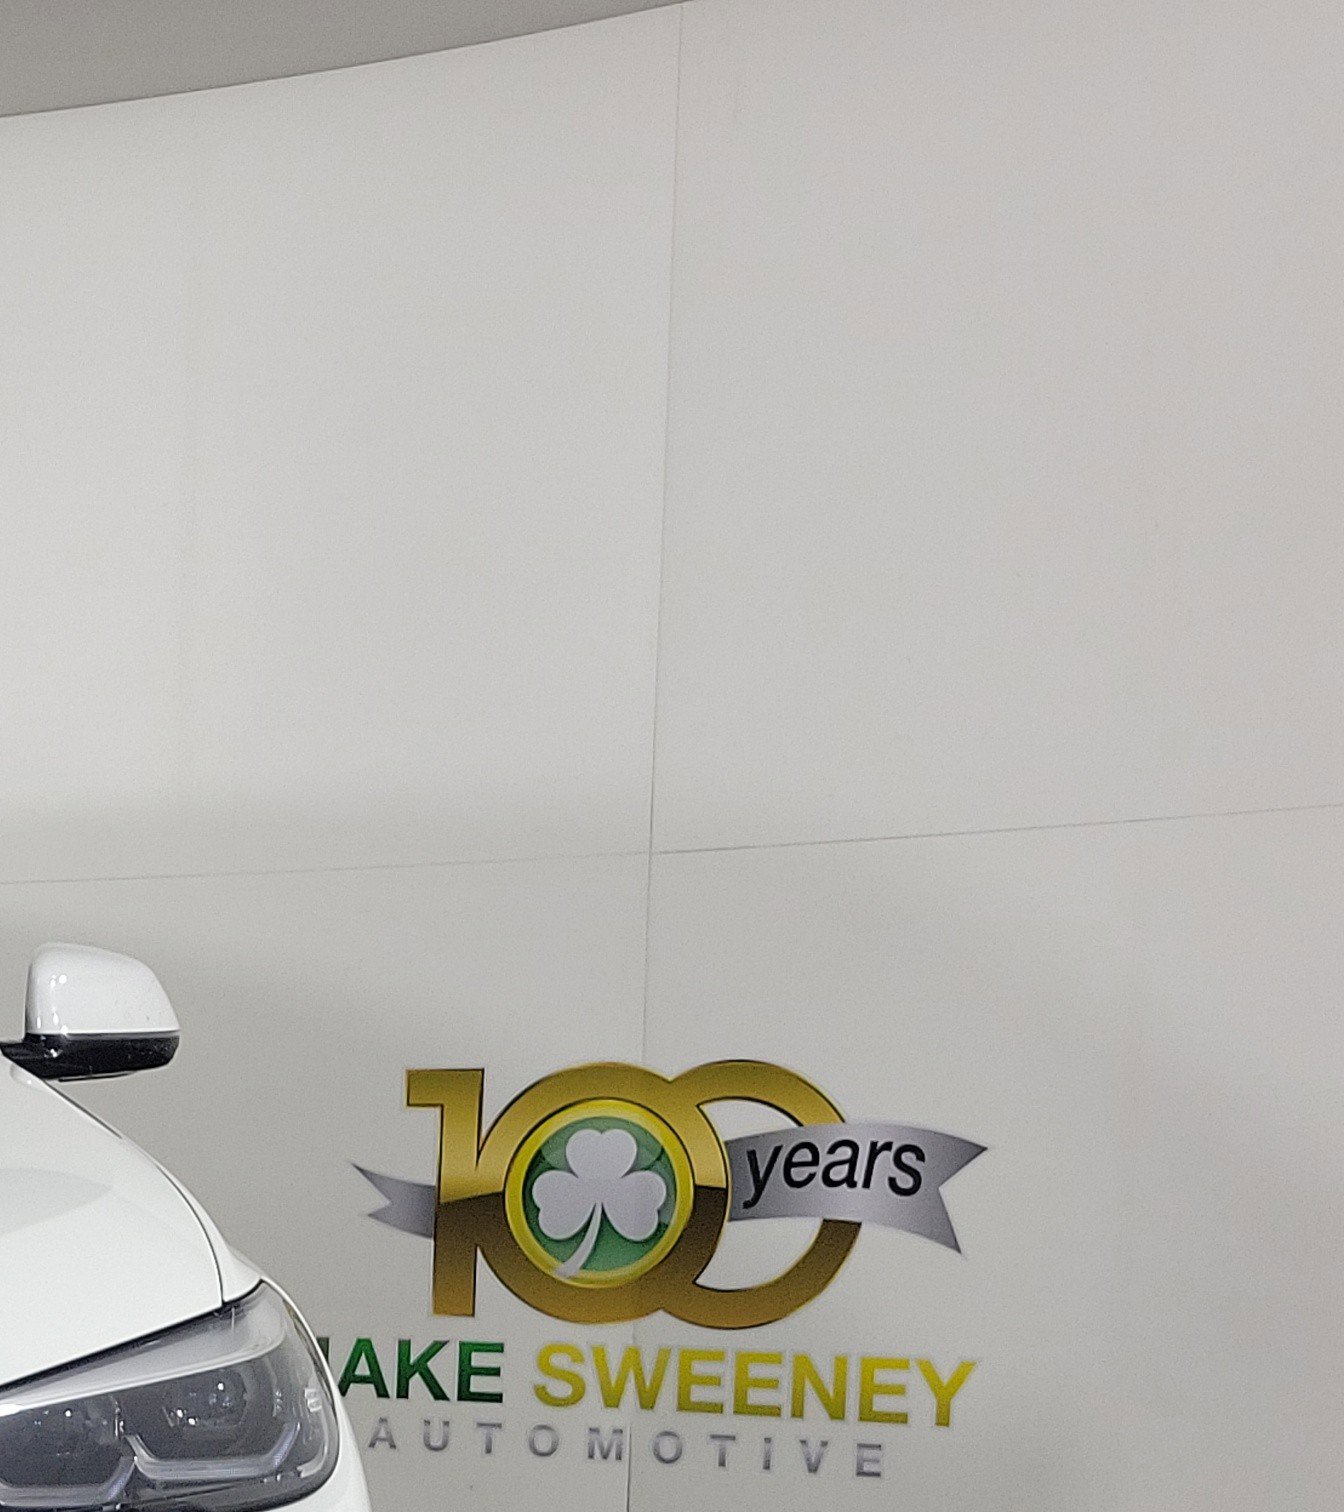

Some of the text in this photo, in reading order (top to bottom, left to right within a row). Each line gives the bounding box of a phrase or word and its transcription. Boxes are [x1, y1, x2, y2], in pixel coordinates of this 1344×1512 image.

[406, 1060, 861, 1330] 100
[742, 1139, 926, 1209] years
[317, 1337, 976, 1427] AKE SWEENEY
[368, 1417, 885, 1478] AUTOMOTIVE
